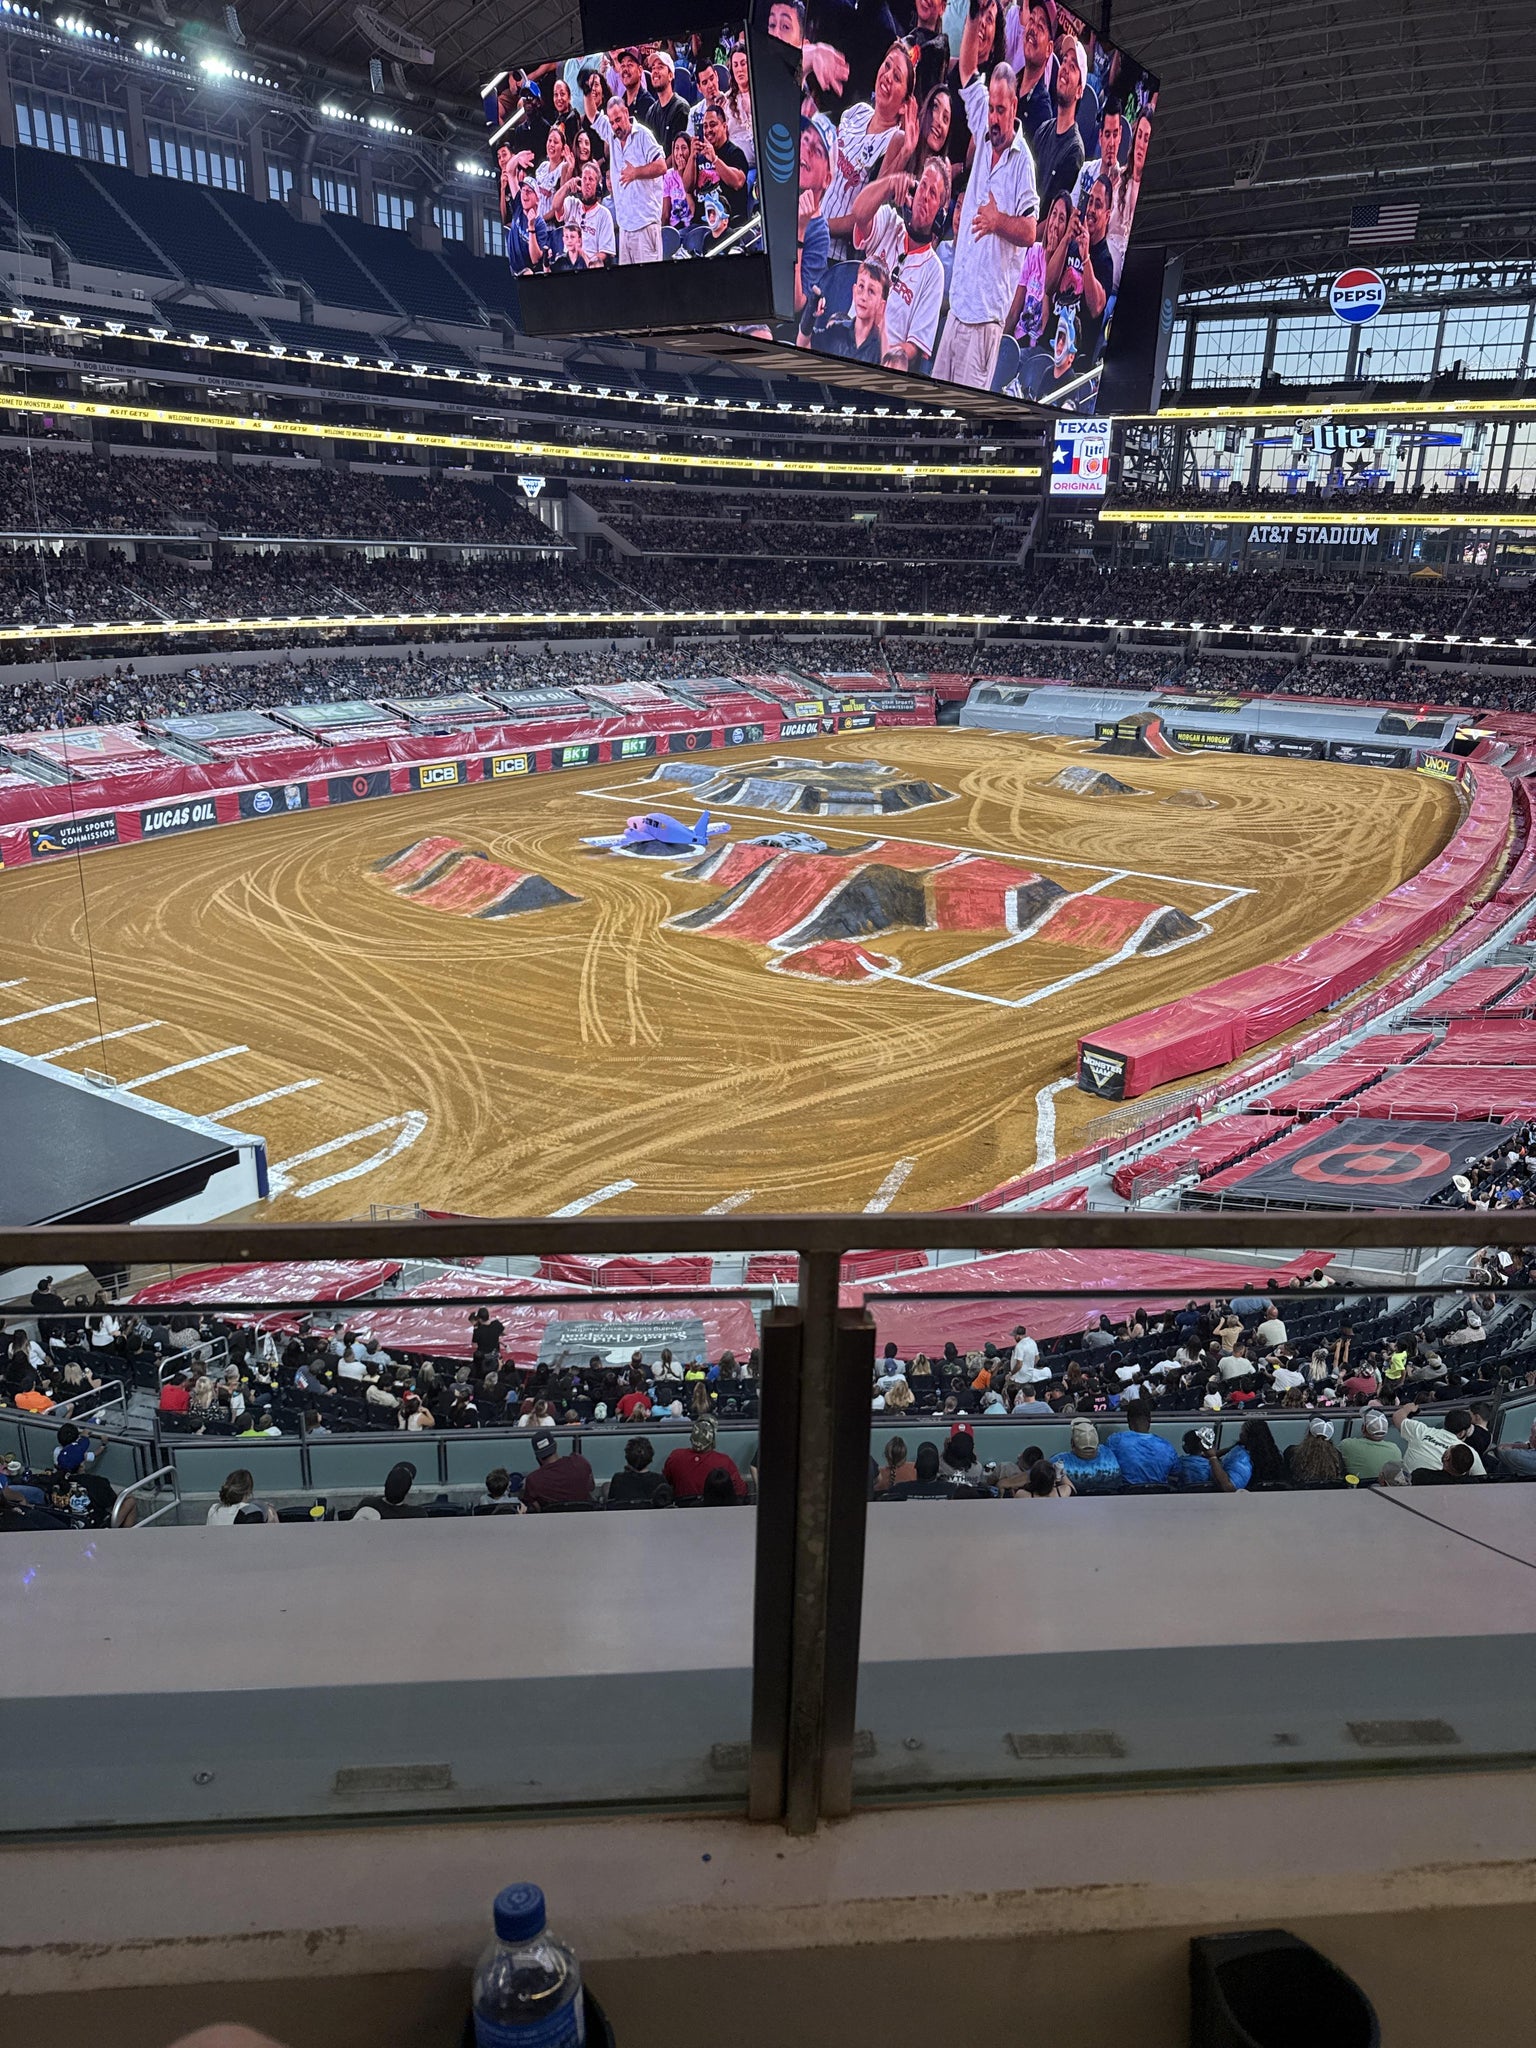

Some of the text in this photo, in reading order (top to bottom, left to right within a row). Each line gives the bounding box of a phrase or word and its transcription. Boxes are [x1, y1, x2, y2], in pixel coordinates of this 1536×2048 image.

[1333, 289, 1382, 303] PEPSI
[84, 362, 98, 371] BOB
[99, 364, 116, 373] LILLY
[222, 379, 244, 388] PERKINS
[24, 400, 50, 408] MONSTER
[52, 402, 64, 410] JAM
[168, 414, 192, 422] WELCOME
[201, 416, 224, 425] MONSTER
[1058, 422, 1108, 434] TEXAS
[1310, 424, 1367, 455] Lite
[1248, 526, 1380, 546] AT&T STADIUM
[501, 691, 571, 702] LUCAS OIL
[781, 724, 806, 737] LUCAS
[806, 722, 819, 734] OIL
[622, 740, 647, 752] BKT
[1178, 734, 1200, 742] MORGAN
[1206, 736, 1230, 744] MORGAN
[563, 748, 588, 760] BKT
[495, 758, 525, 773] JCB
[1424, 756, 1451, 772] UNOH
[423, 767, 455, 783] JCB
[144, 803, 215, 832] LUCAS OIL
[60, 820, 115, 838] UTAH SPORTS
[61, 830, 116, 846] COMMISSION
[1083, 1056, 1122, 1074] MONSTER
[1092, 1066, 1113, 1078] JAM
